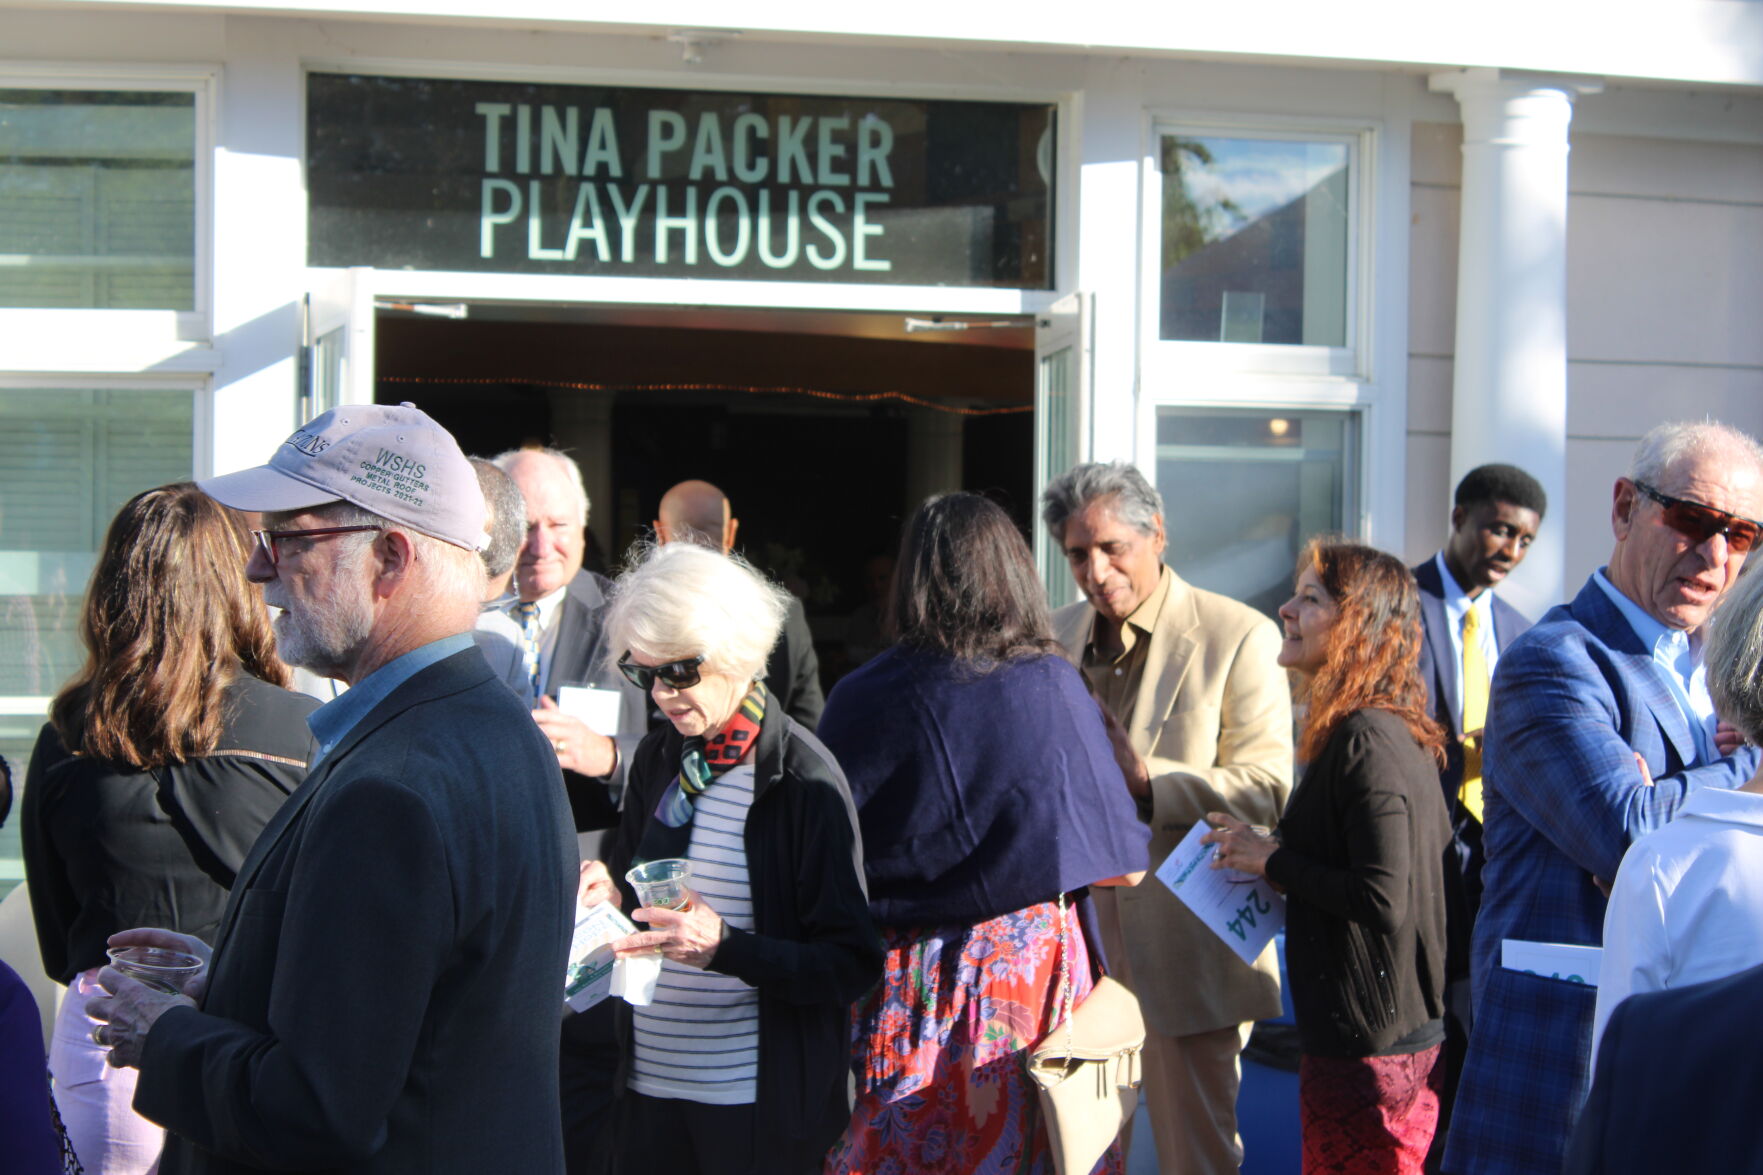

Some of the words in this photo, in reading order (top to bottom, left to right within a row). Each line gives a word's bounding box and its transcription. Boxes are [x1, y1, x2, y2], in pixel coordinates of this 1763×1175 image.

[474, 102, 622, 177] TINA
[646, 109, 895, 188] PACKER
[479, 178, 892, 271] PLAYHOUSE
[360, 461, 392, 478] COPPER
[393, 473, 430, 492] GUTTERS
[375, 447, 426, 479] WSHS
[350, 474, 392, 495] PROJECTS
[366, 472, 390, 487] METAL
[393, 481, 417, 494] ROOF
[1226, 888, 1271, 941] 244
